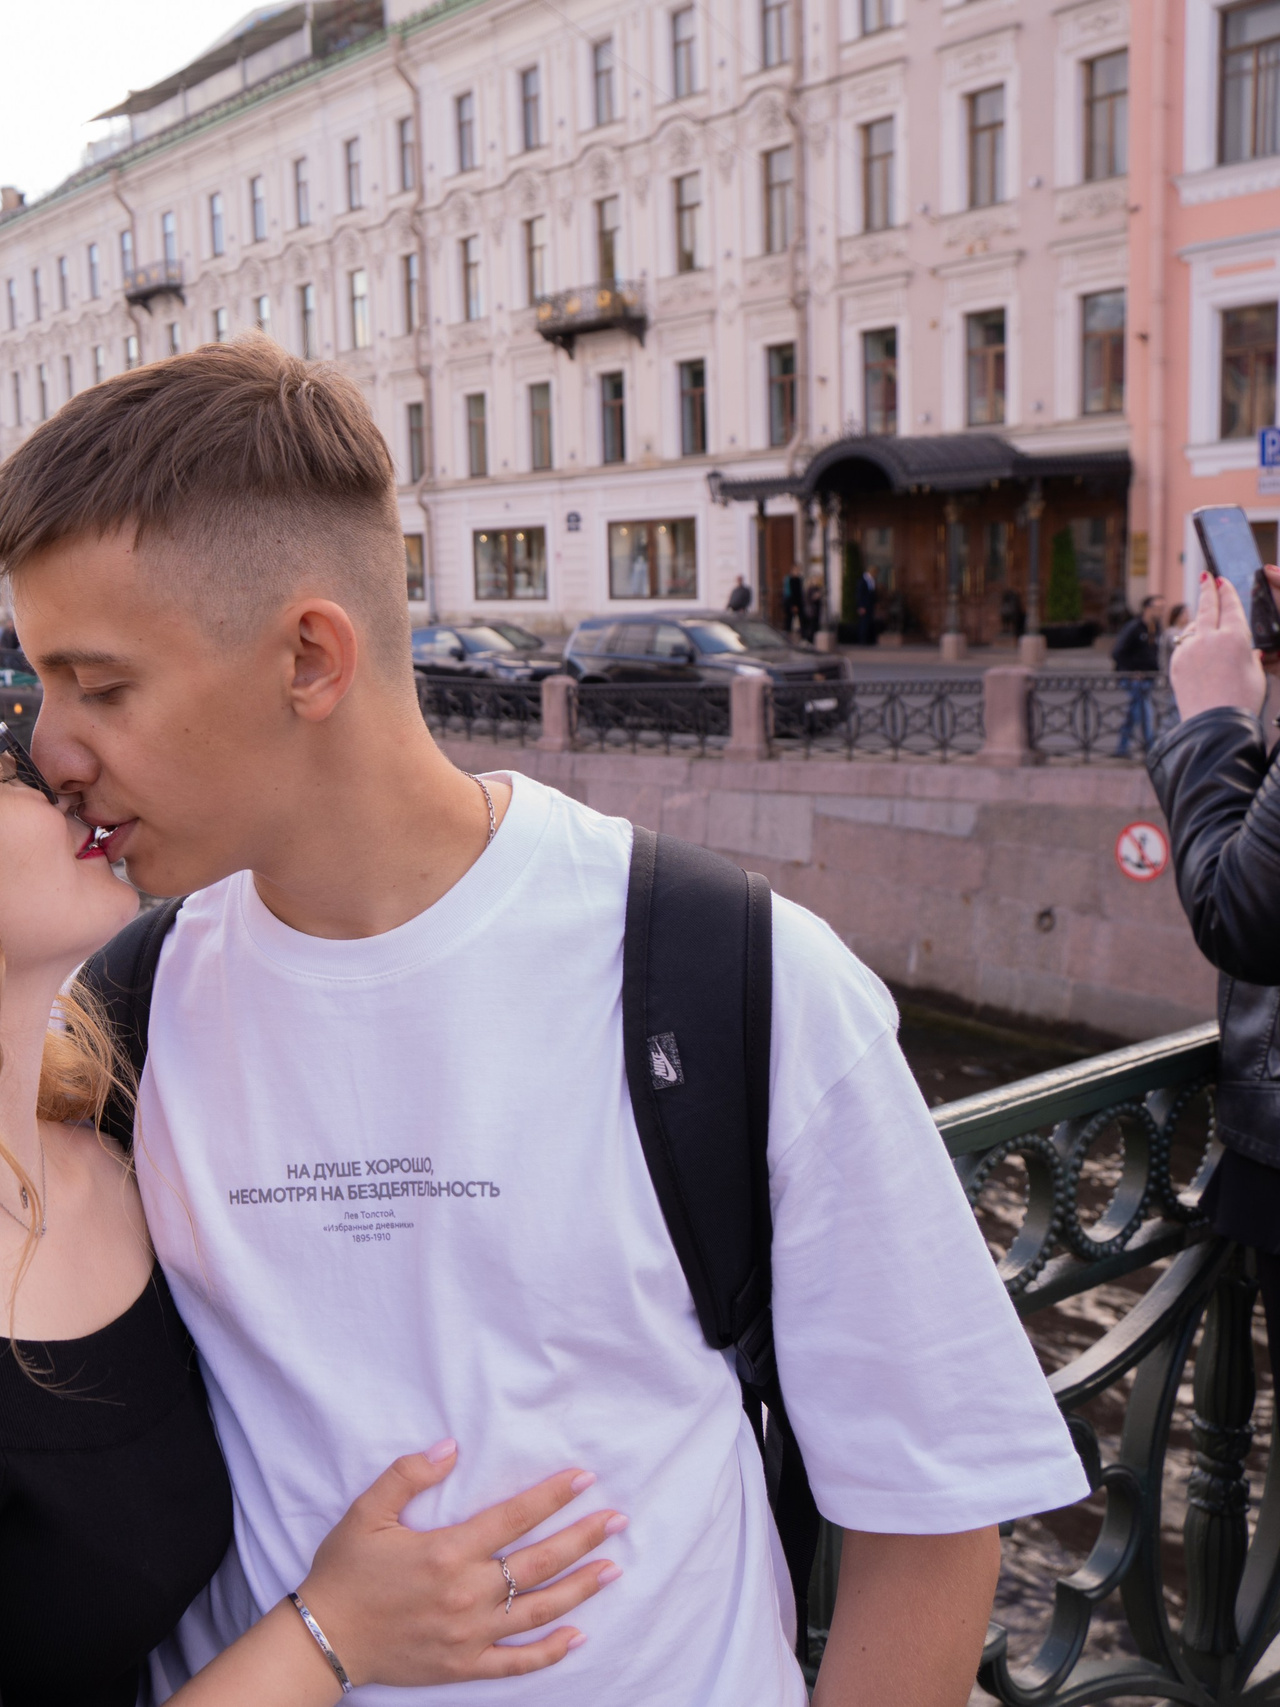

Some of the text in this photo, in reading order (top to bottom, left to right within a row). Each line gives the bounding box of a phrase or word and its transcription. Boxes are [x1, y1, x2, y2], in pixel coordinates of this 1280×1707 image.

[287, 1156, 434, 1181] НА ДУШЕ ХОРОШО,
[229, 1180, 501, 1205] НЕСМОТРЯ НА БЕЗДЕЯТЕЛЬНОСТЬ
[343, 1208, 396, 1220] Лев Толстой,
[322, 1221, 415, 1233] «Избранные дневники»
[352, 1232, 391, 1243] 1895-1910
